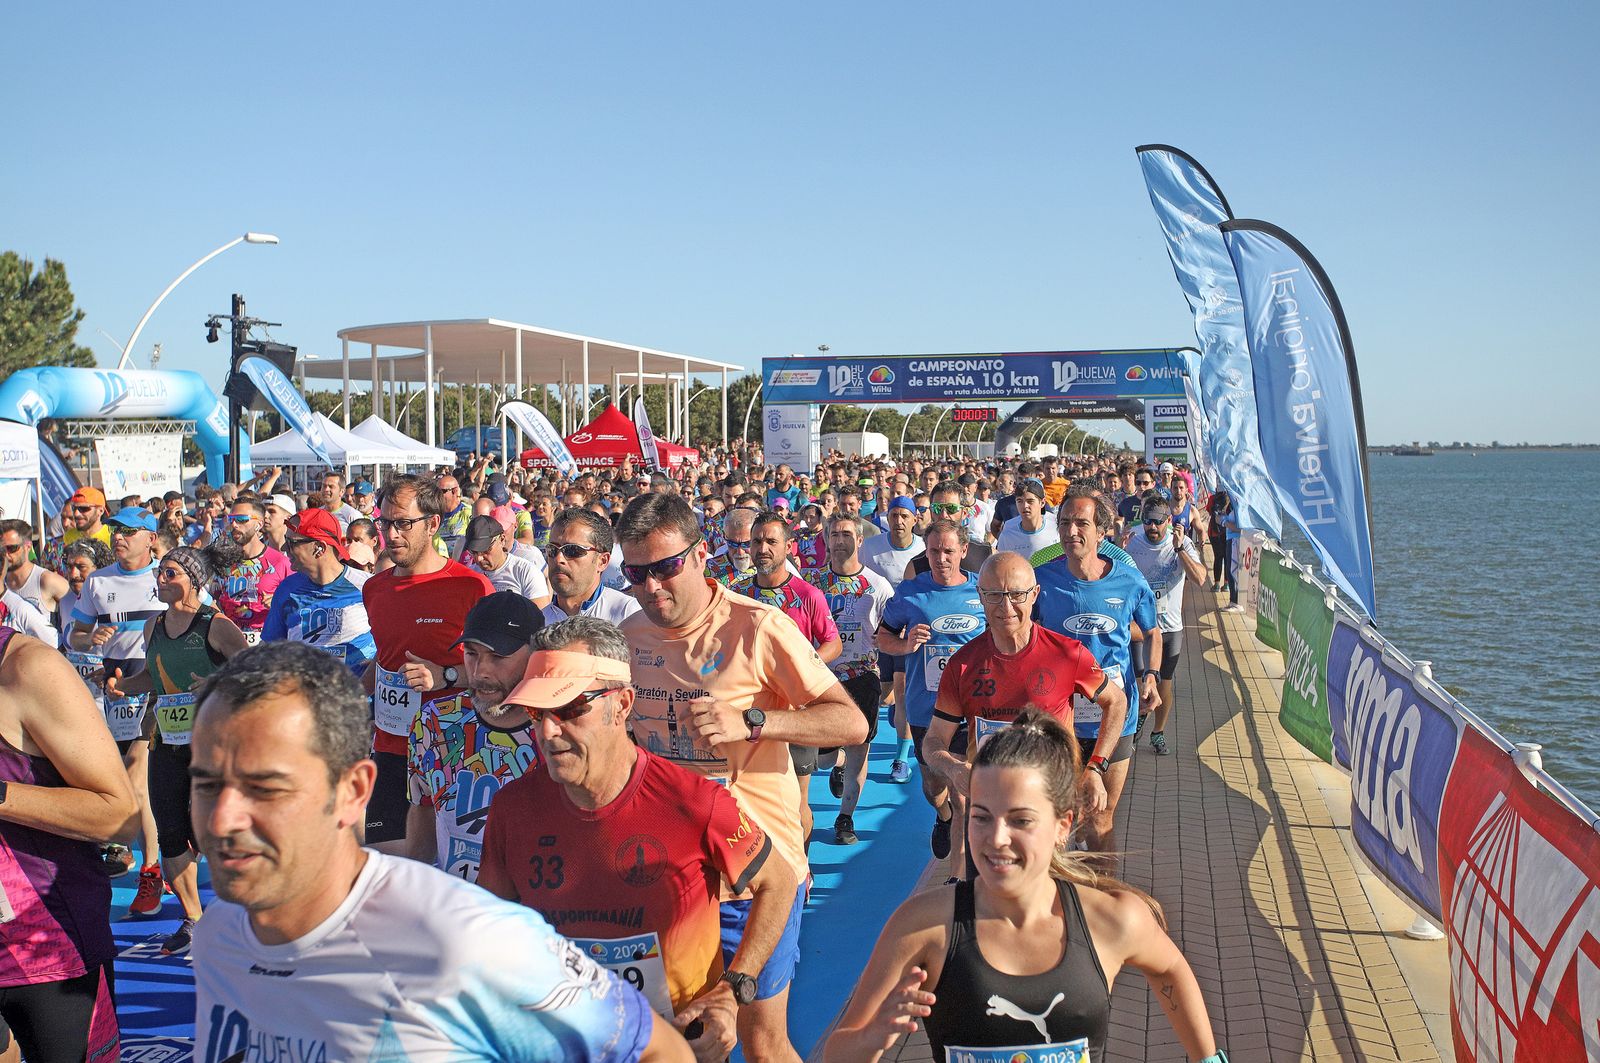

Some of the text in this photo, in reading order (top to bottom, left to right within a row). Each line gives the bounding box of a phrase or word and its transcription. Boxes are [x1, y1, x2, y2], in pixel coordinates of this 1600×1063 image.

[908, 359, 1005, 372] CAMPEONATO
[1076, 366, 1117, 379] HUELVA
[1150, 367, 1186, 380] WiHu
[908, 371, 1040, 387] de ESPAÑA 10 km
[128, 379, 168, 398] HUELVA
[972, 387, 1005, 395] Absoluto
[1013, 387, 1040, 395] Master
[942, 616, 970, 631] Ford
[1074, 615, 1107, 631] Ford
[378, 684, 410, 708] 1464
[972, 679, 996, 697] 23
[114, 705, 144, 720] 1067
[162, 707, 189, 723] 742
[528, 855, 565, 889] 33
[613, 942, 647, 960] 2023
